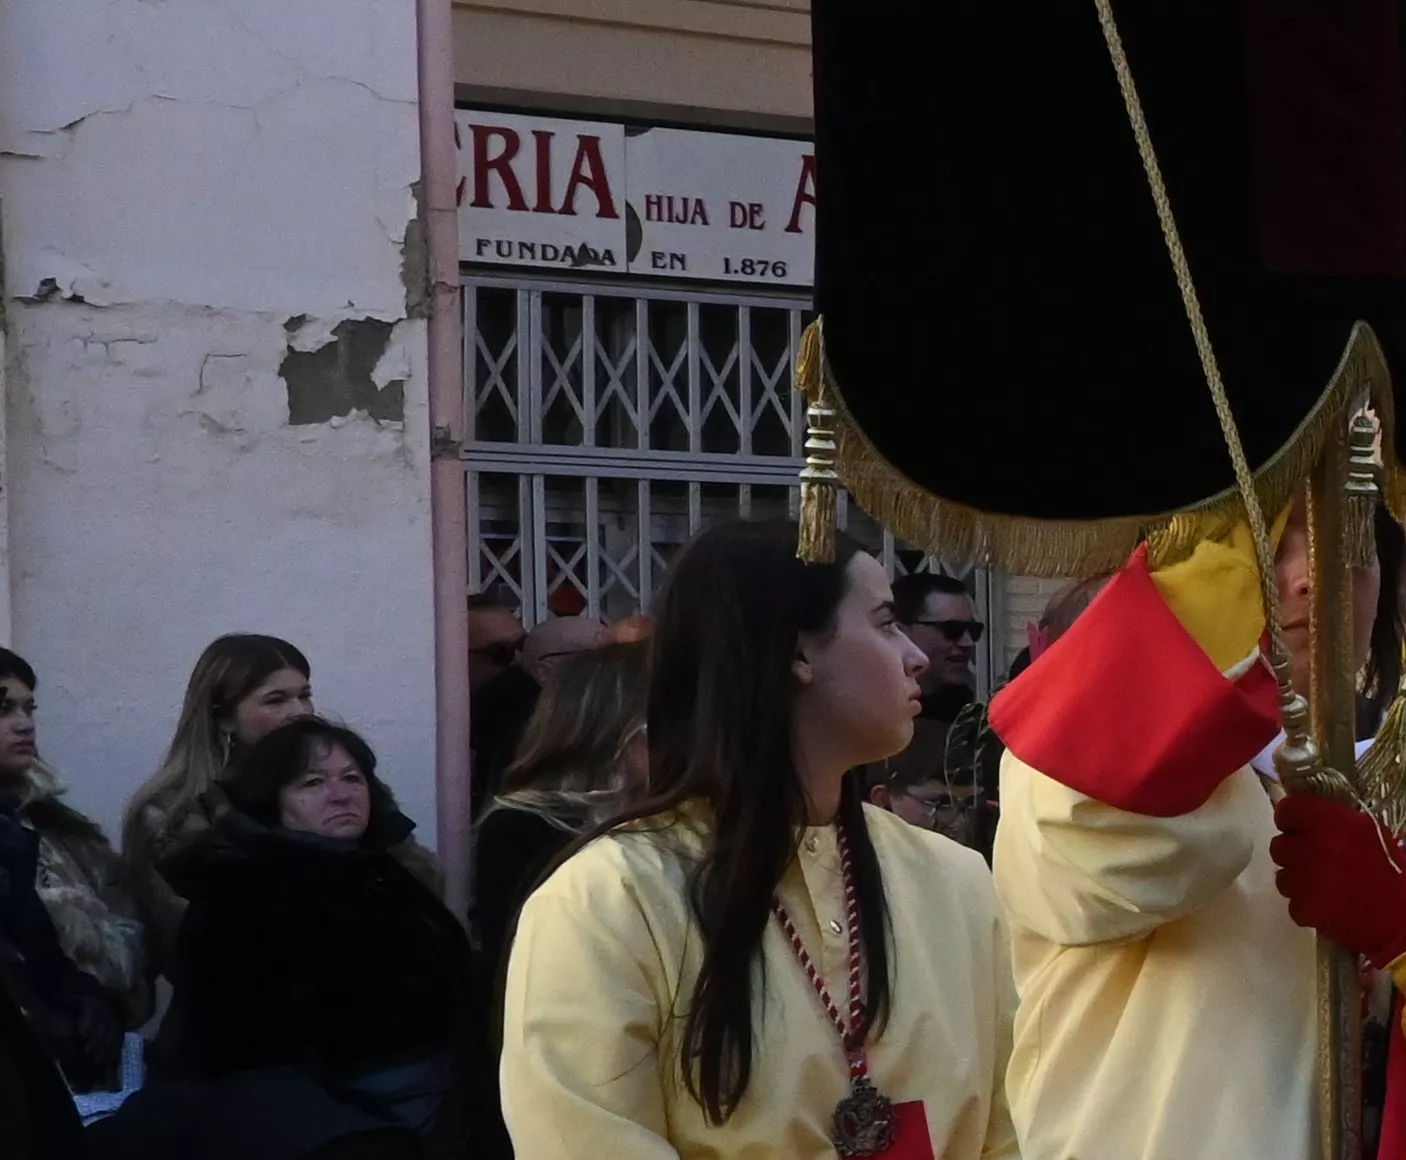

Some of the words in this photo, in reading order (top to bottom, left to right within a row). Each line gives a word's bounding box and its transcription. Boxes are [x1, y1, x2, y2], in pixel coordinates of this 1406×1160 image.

[454, 121, 620, 219] RIA
[645, 194, 710, 226] HIJA
[729, 201, 767, 230] DE
[651, 251, 687, 271] EN
[723, 257, 788, 278] 1.876
